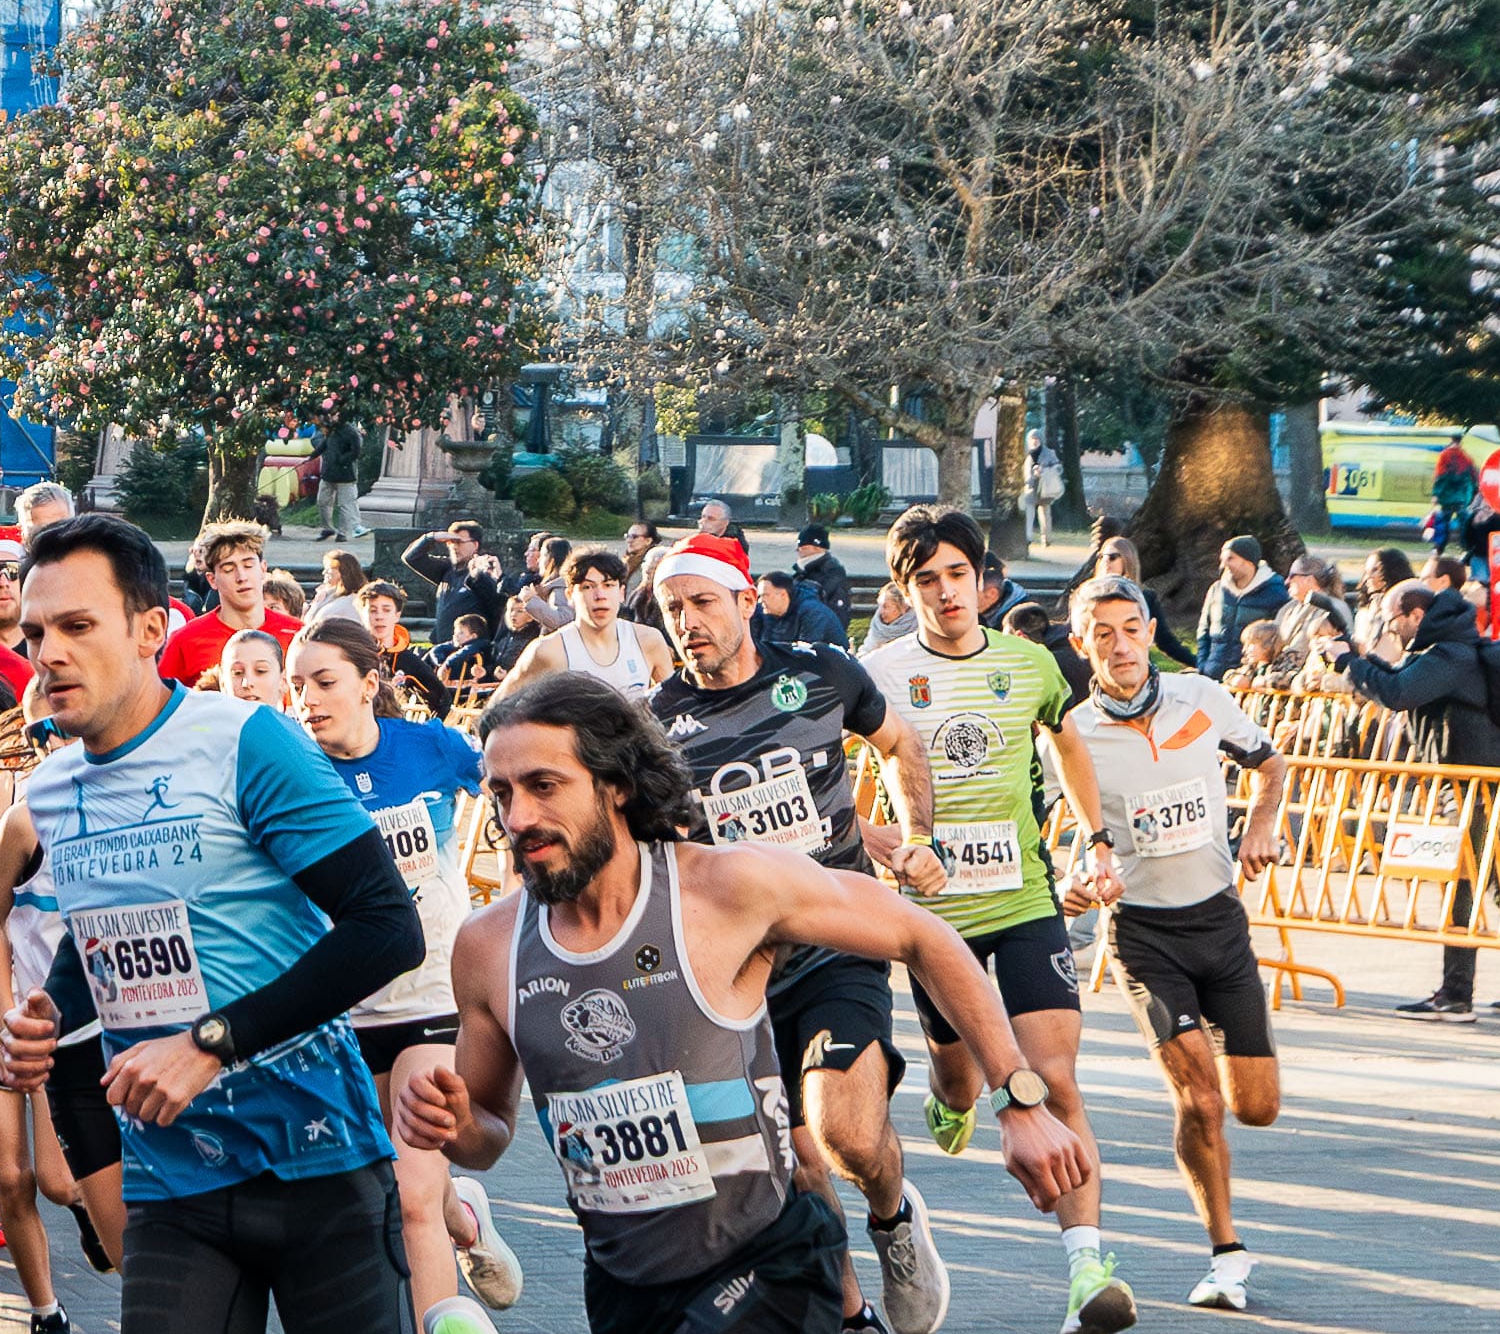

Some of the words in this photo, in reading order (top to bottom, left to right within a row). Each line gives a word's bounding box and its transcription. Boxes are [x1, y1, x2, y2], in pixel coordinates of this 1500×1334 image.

[729, 793, 751, 813] SAN
[752, 775, 803, 807] SILVESTRE
[748, 795, 809, 836] 3103
[1159, 796, 1206, 829] 3785
[63, 842, 92, 863] GRAN
[93, 833, 129, 855] FONDO
[130, 822, 202, 848] CAIXABANK
[947, 826, 967, 842] SAN
[968, 822, 1013, 842] SILVESTRE
[961, 839, 1015, 866] 4541
[74, 914, 99, 940] XLII
[99, 914, 123, 939] SAN
[121, 906, 181, 938] SILVESTRE
[114, 933, 193, 981] 6590
[120, 986, 176, 1004] PONTEVEDRA
[176, 978, 199, 997] 2025
[518, 976, 572, 1005] ARION
[565, 1099, 599, 1125] SAN
[599, 1079, 679, 1118] SILVESTRE
[594, 1108, 690, 1166] 3881
[604, 1163, 669, 1188] PONTEVEDRA
[672, 1155, 699, 1177] 2025
